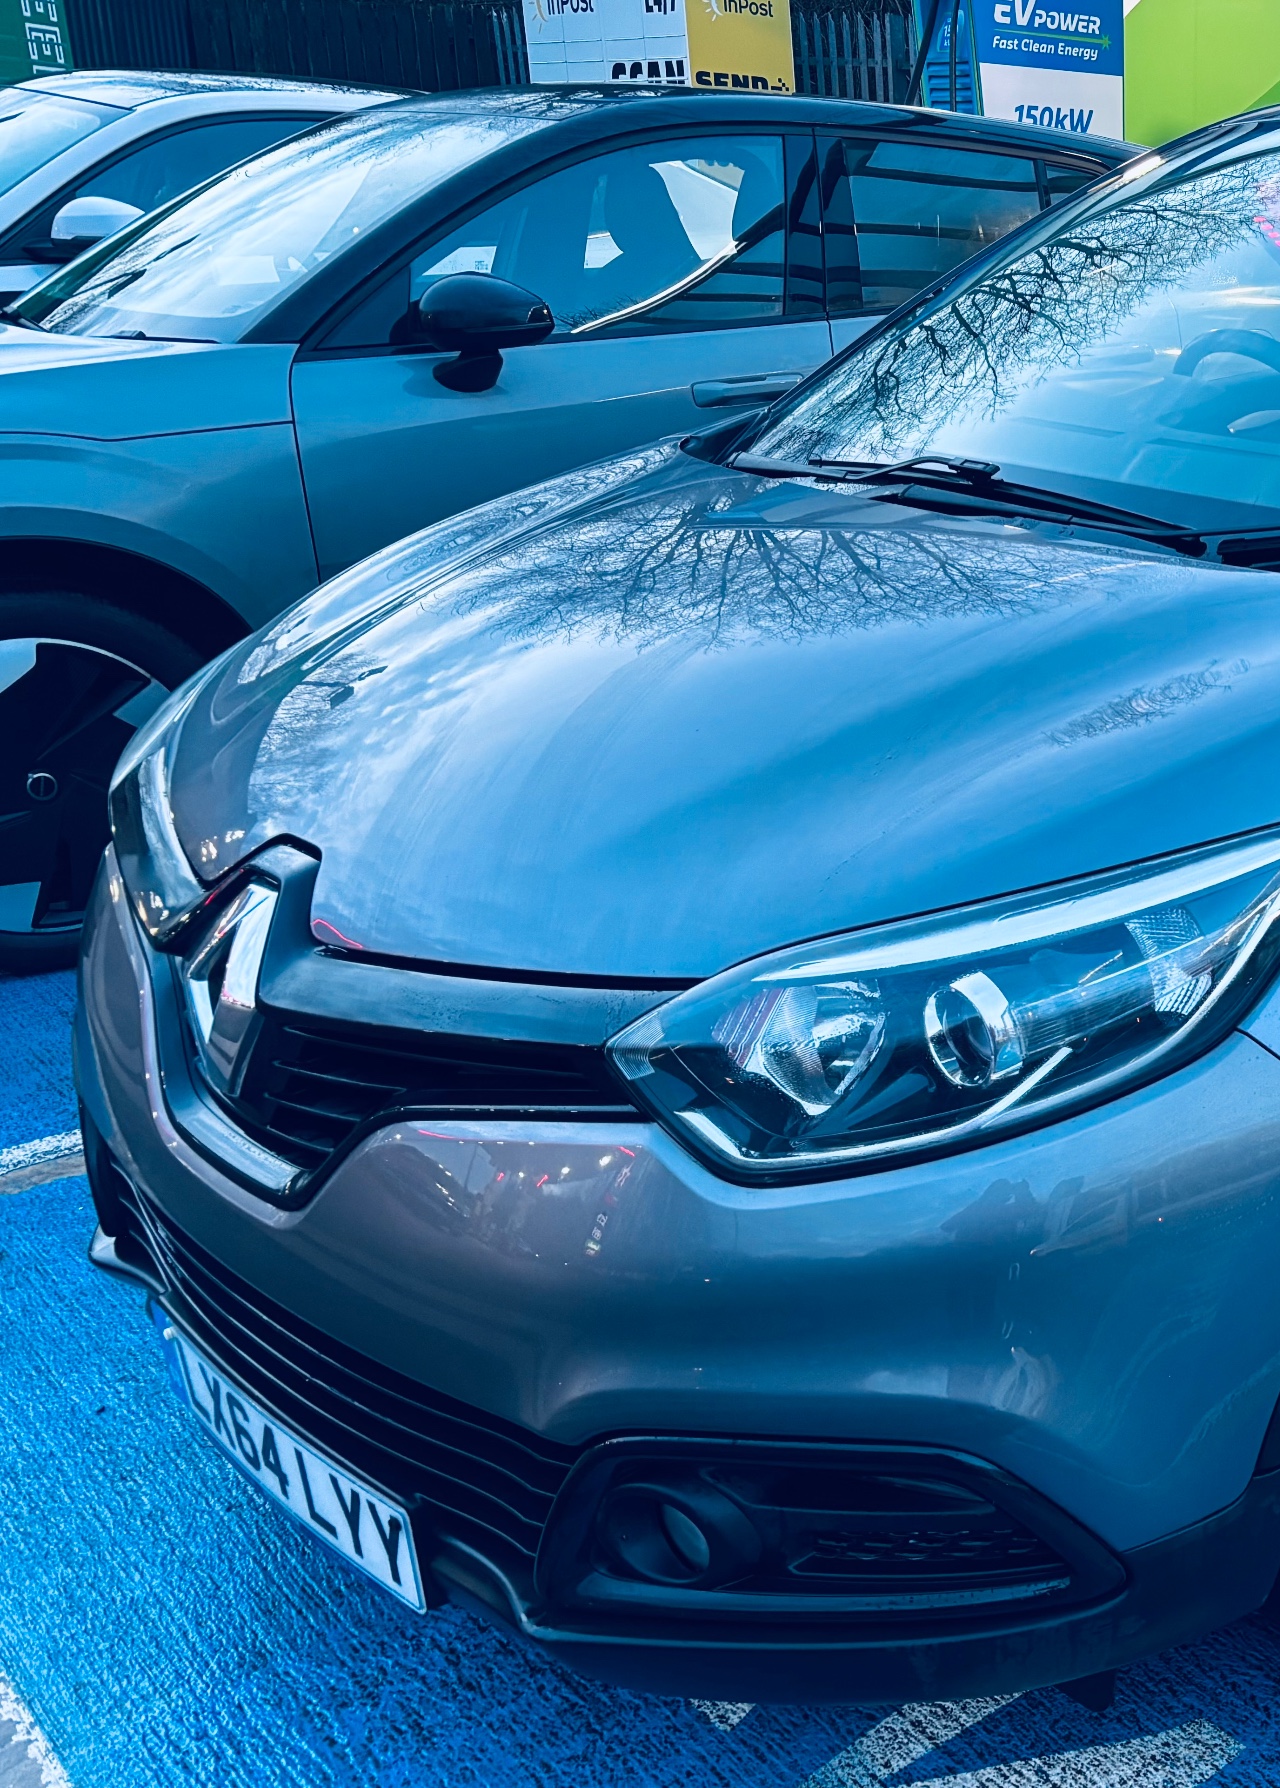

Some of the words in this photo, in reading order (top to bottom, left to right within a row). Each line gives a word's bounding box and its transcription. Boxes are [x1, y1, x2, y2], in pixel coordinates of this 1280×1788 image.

[992, 35, 1019, 50] Fast
[1021, 38, 1055, 54] Clean
[1057, 42, 1099, 61] Energy
[1014, 104, 1094, 134] 150kW
[174, 1339, 290, 1500] LX64
[294, 1446, 403, 1588] LYY
